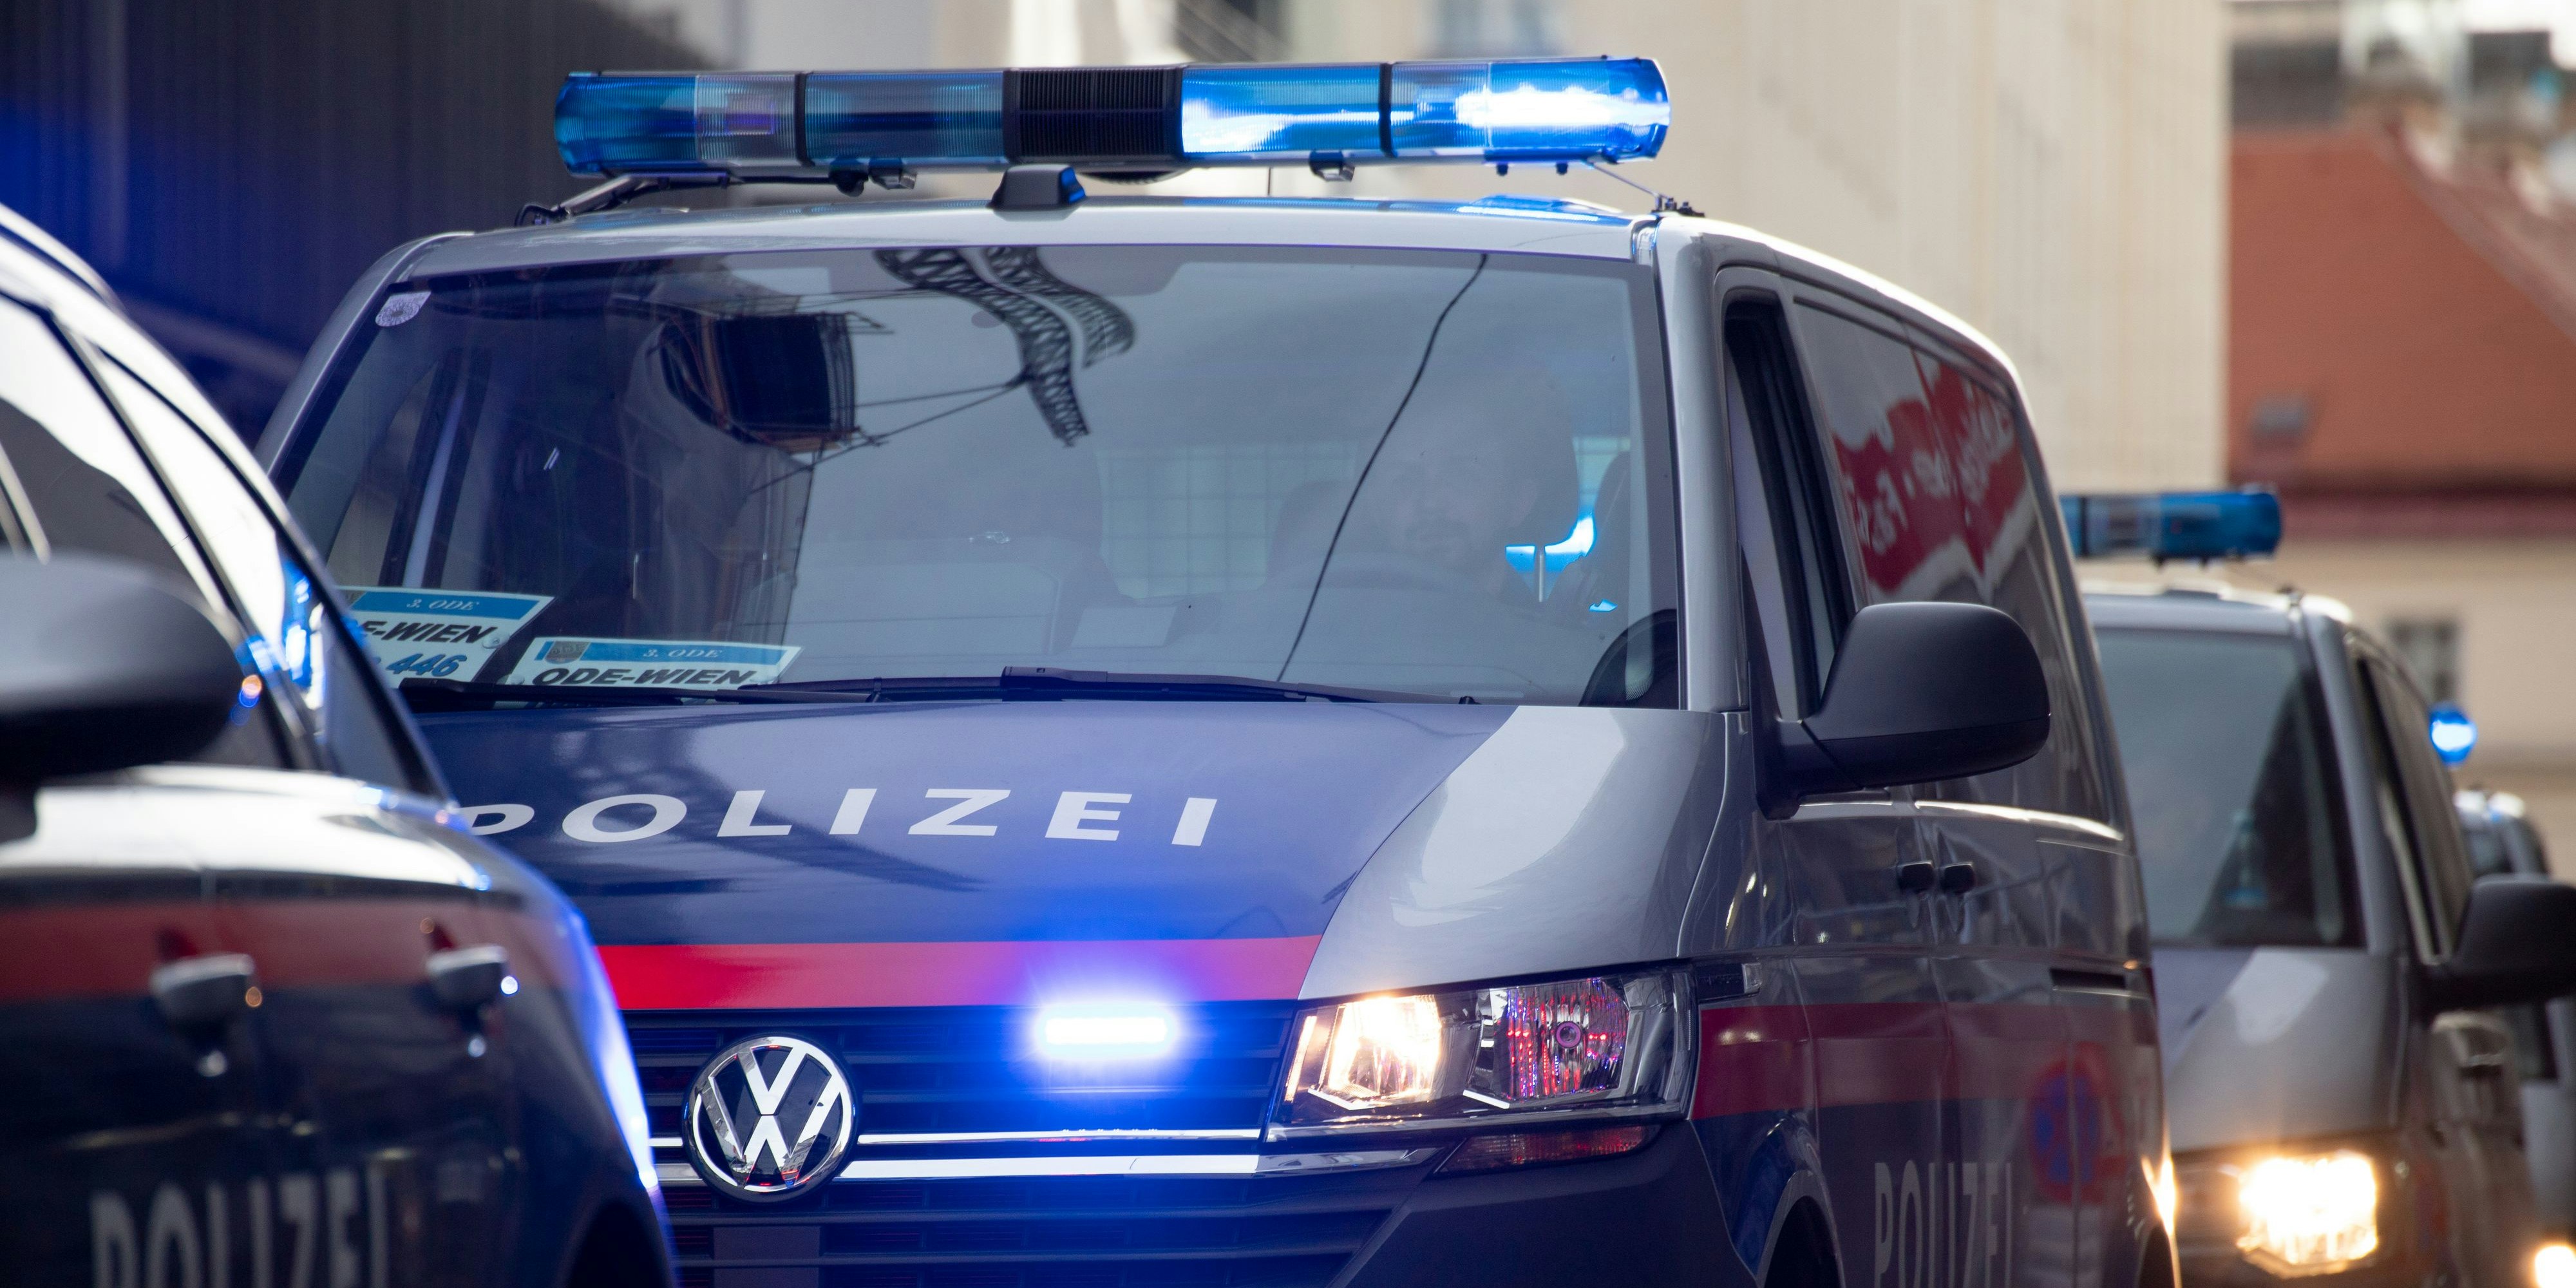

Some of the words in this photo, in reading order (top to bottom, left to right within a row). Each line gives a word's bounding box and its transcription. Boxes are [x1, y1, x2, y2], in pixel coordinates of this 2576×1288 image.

[407, 599, 422, 609] 3.
[429, 600, 479, 611] ODE
[362, 620, 498, 644] E-WIEN
[643, 649, 658, 657] 3.
[386, 653, 468, 677] 446
[532, 668, 757, 685] ODE-WIEN
[455, 788, 1218, 846] POLIZEI
